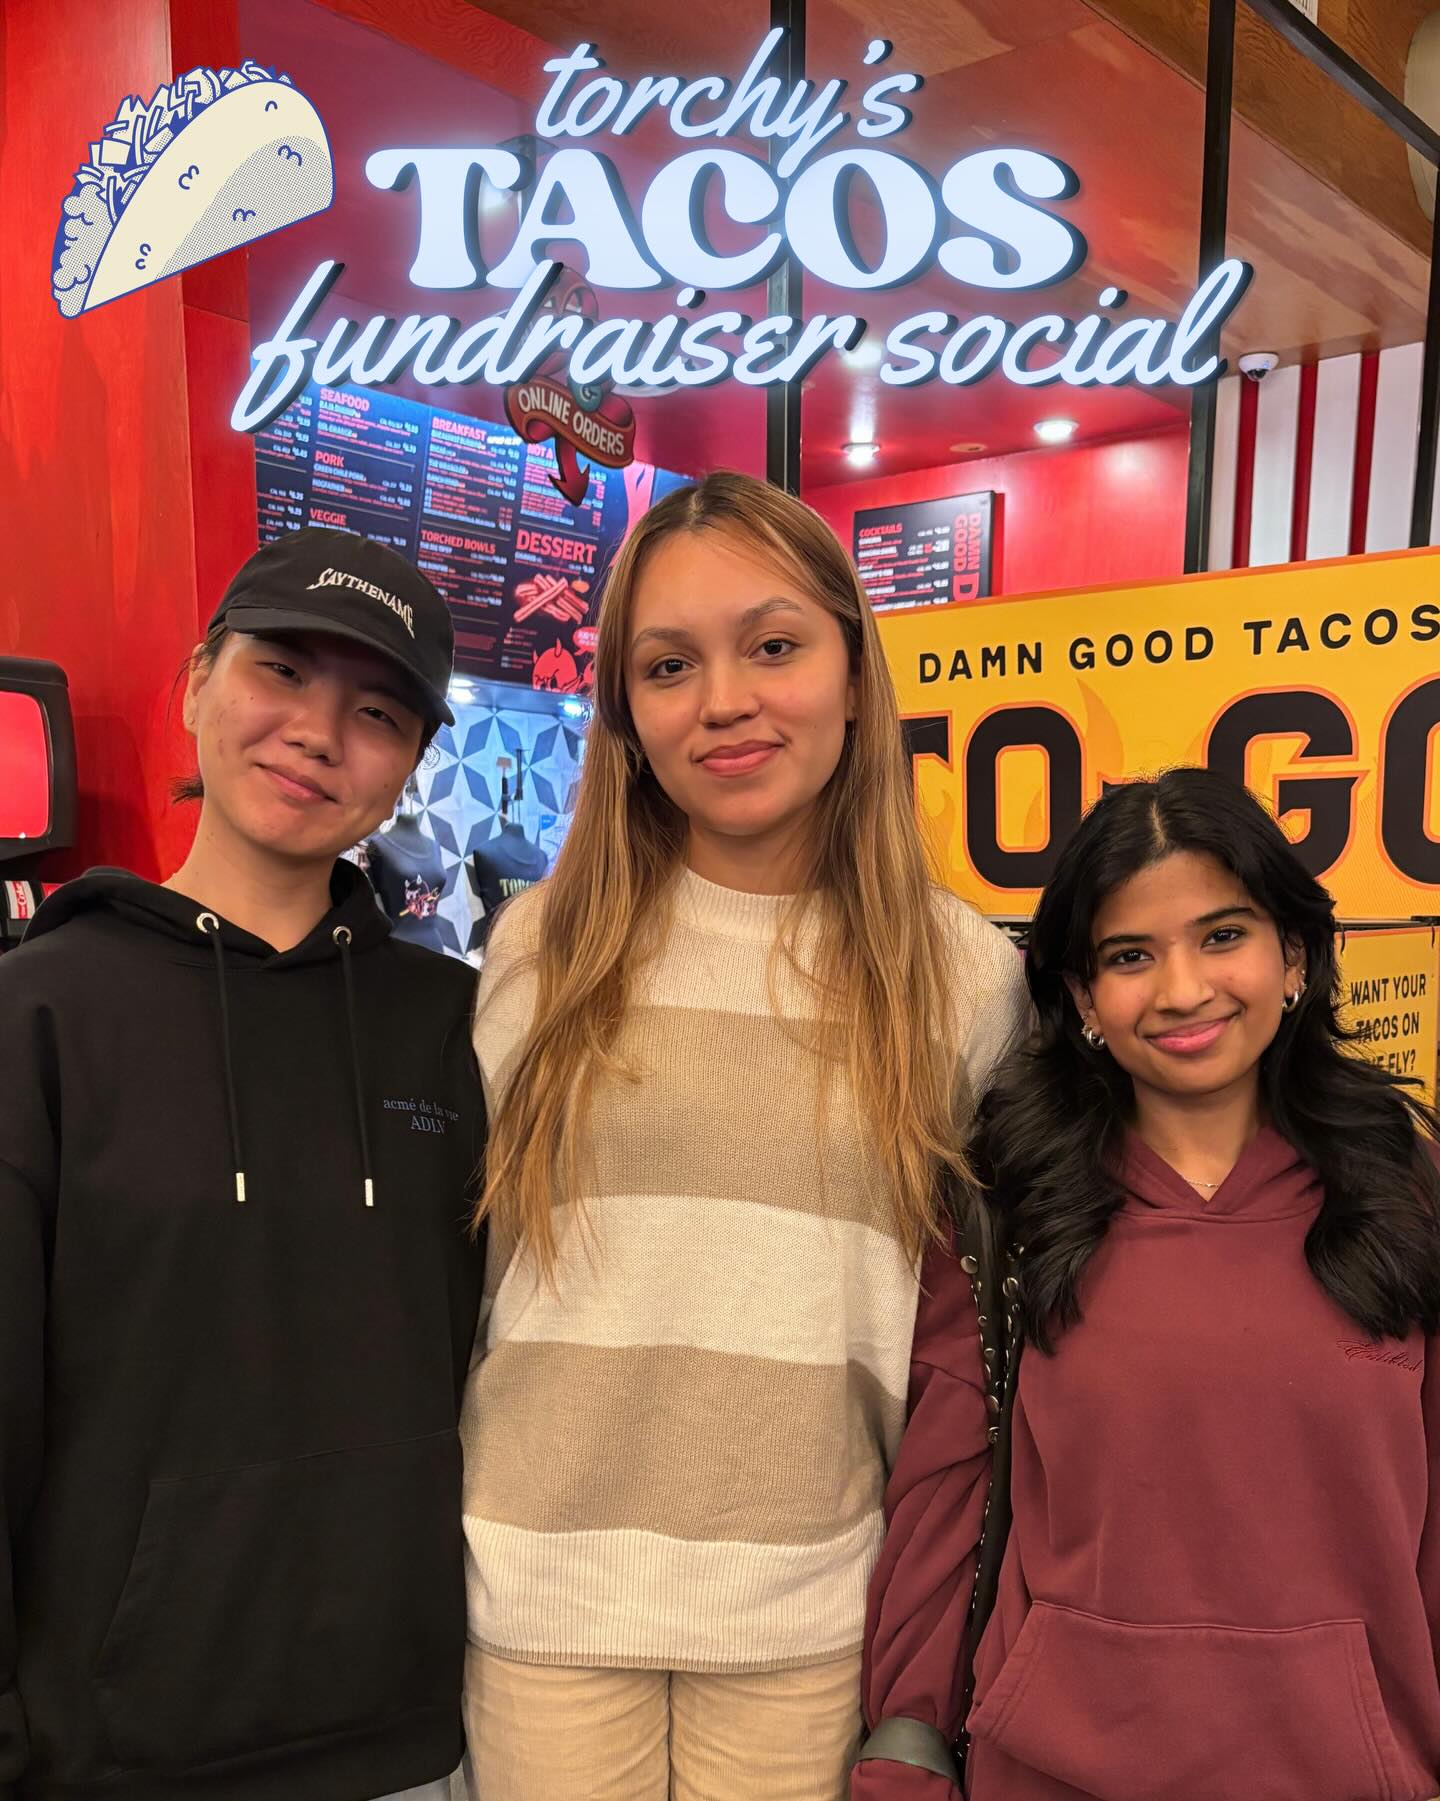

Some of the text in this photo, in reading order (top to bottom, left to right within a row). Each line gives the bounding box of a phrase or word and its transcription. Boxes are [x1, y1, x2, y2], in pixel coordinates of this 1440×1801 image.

[320, 387, 369, 412] SEAFOOD
[431, 416, 487, 442] BREAKFAST
[517, 386, 625, 456] ONLINE ORDERS
[315, 450, 345, 468] PORK
[310, 507, 347, 526] VEGGIE
[421, 529, 463, 548] TORCHED
[463, 538, 496, 555] BOWLS
[858, 523, 903, 538] COCKTAILS
[953, 513, 968, 573] GOOD
[967, 512, 981, 570] DAMN
[516, 529, 597, 564] DESSERT
[919, 604, 1440, 684] DAMN GOOD TACOS
[1351, 974, 1426, 1006] WANT YOUR
[1356, 1011, 1420, 1044] TACOS ON
[1388, 1049, 1416, 1074] FLY?
[419, 1099, 432, 1114] de
